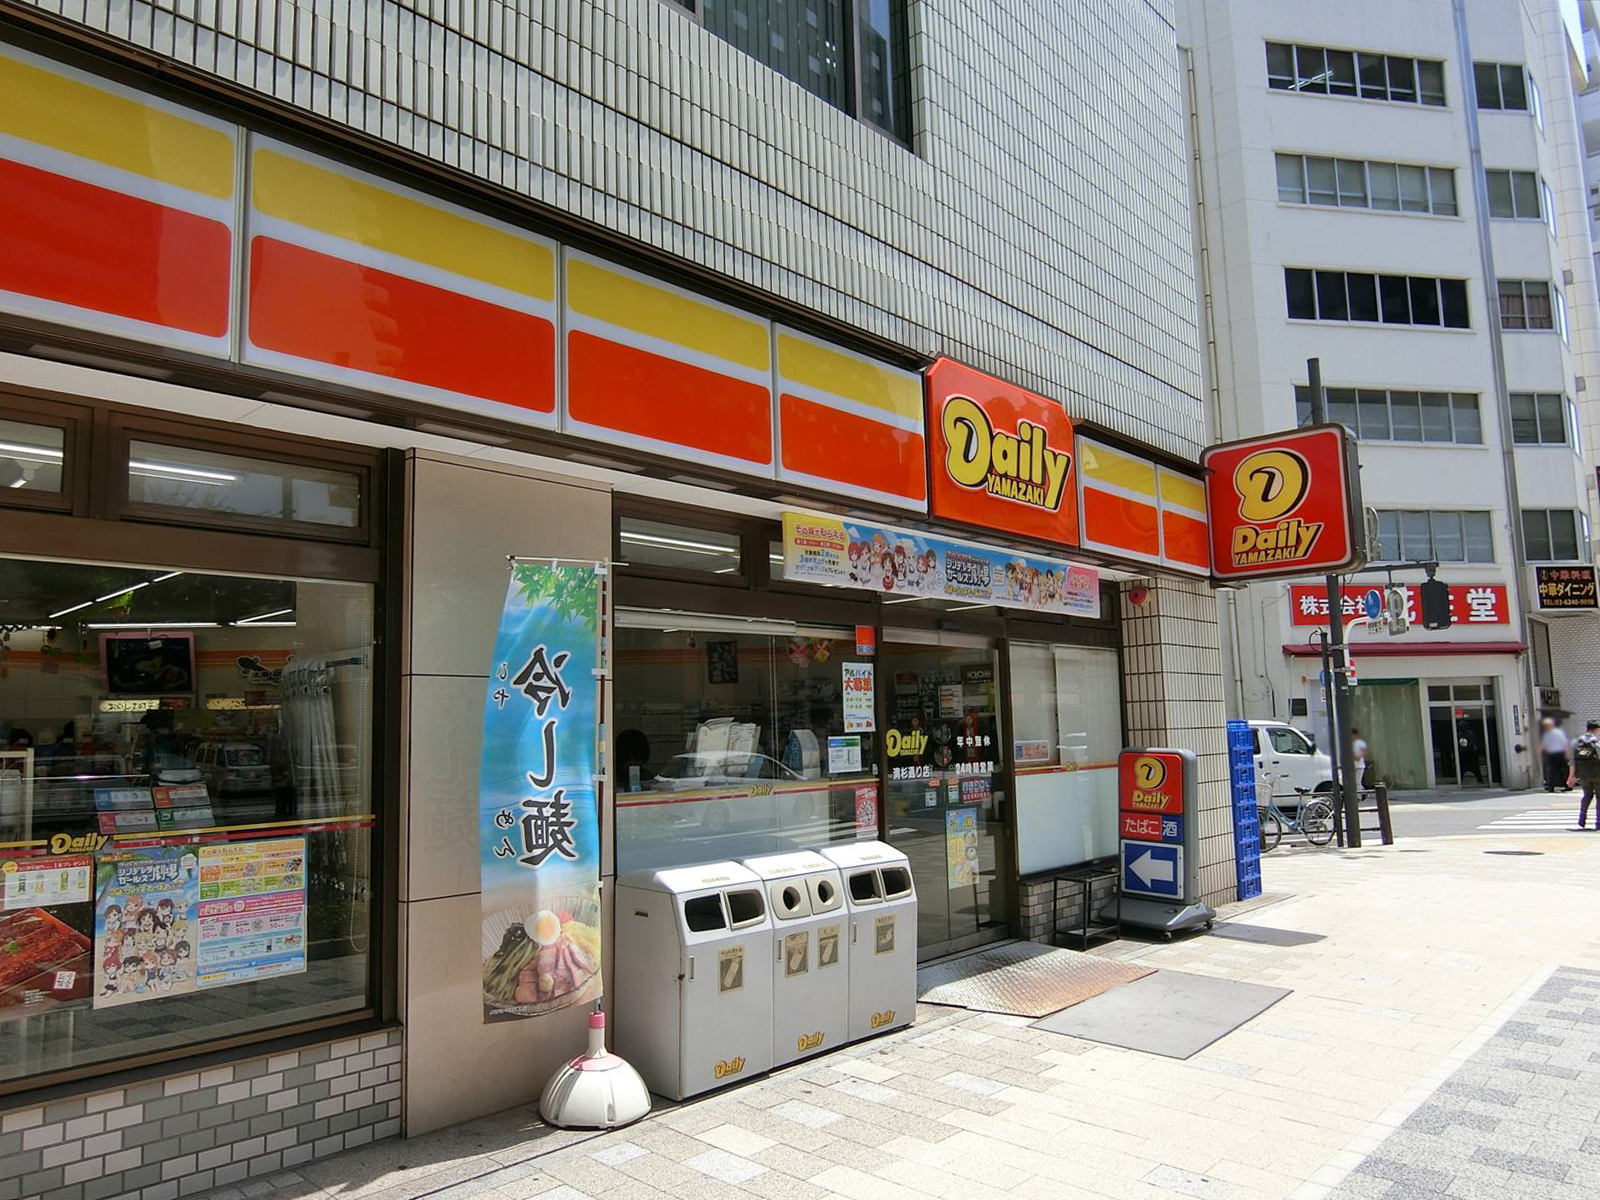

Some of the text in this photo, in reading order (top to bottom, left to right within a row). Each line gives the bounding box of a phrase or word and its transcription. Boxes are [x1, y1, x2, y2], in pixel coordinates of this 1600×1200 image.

[943, 396, 1071, 511] Daily
[987, 472, 1045, 506] YAMAZAKI
[1234, 519, 1323, 559] Daily
[1234, 547, 1296, 566] YAMAZAKI
[1539, 582, 1595, 597] 中華ダイニング
[844, 668, 873, 678] アルバイト
[886, 728, 929, 757] Daily
[956, 735, 991, 748] 年中無休
[955, 761, 994, 776] 24時間営業
[1132, 790, 1171, 810] Daily
[1125, 818, 1178, 837] たばこ 酒
[51, 832, 109, 855] Daily
[118, 866, 153, 877] シンデレラ
[118, 875, 150, 886] ガールズ
[871, 1010, 896, 1029] Daily
[797, 1031, 826, 1052] Daily
[714, 1056, 746, 1080] Daily
